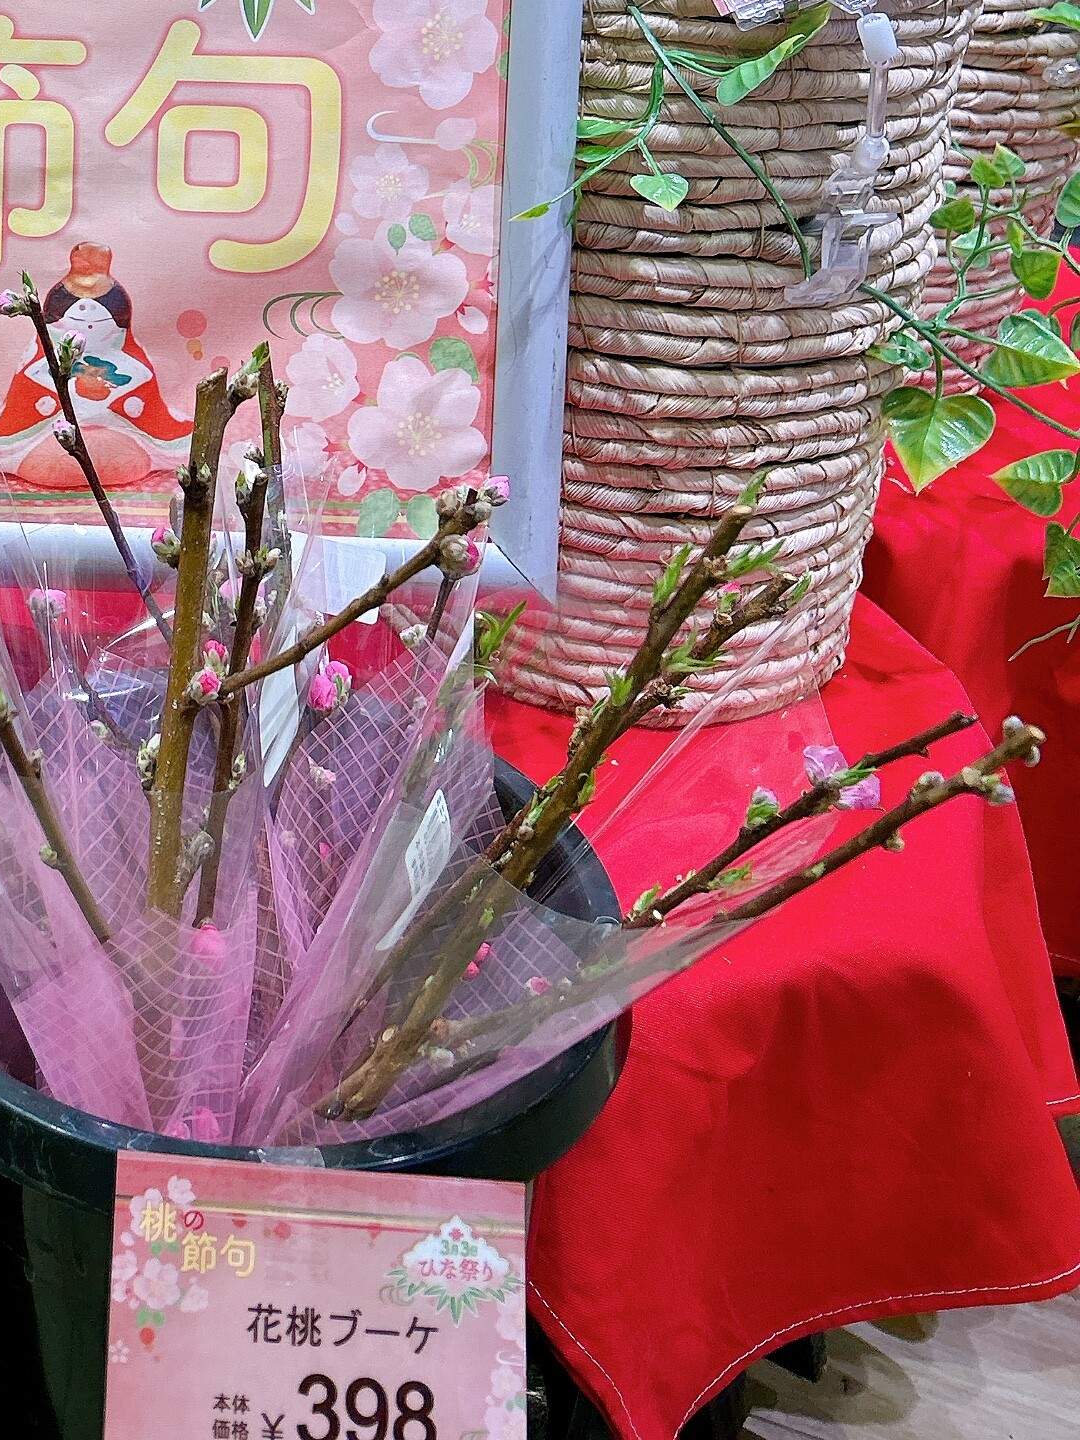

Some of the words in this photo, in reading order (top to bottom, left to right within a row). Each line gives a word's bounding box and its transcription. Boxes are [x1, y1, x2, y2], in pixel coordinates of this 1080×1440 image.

[139, 1200, 204, 1243] 桃の
[181, 1231, 257, 1278] 節句
[418, 1258, 493, 1283] ひな祭り
[247, 1302, 440, 1354] 花桃ブーケ
[213, 1393, 250, 1415] 本体
[212, 1418, 250, 1440] 価格
